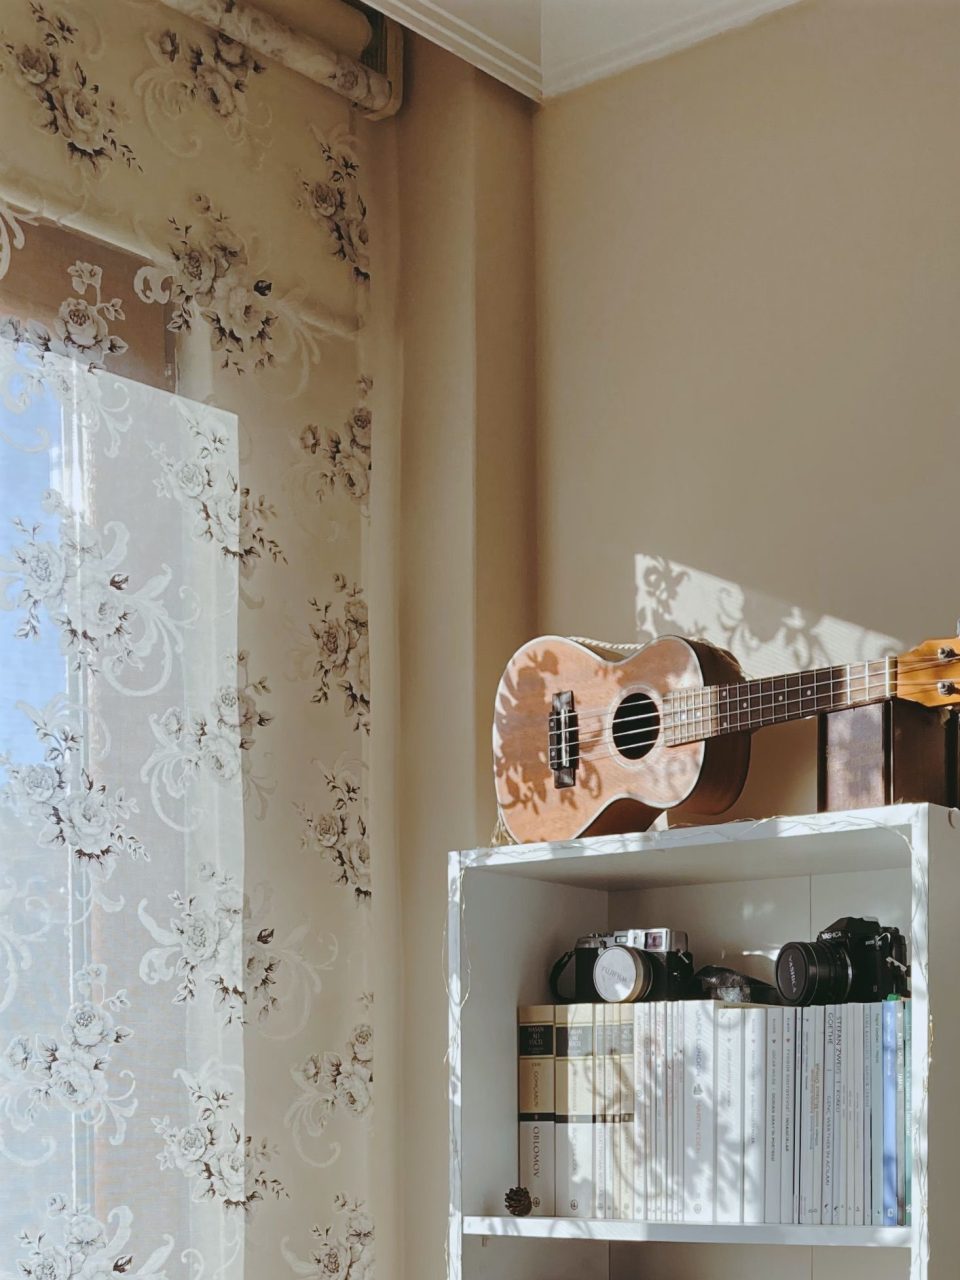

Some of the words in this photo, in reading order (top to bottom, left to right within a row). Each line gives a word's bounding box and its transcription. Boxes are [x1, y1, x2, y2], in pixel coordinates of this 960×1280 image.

[693, 1010, 703, 1037] JACK
[826, 1012, 834, 1045] GOETHE
[834, 1015, 843, 1047] STEFAN
[693, 1038, 703, 1077] LONDON
[834, 1048, 843, 1076] ZWEIG
[532, 1125, 542, 1178] OBLOMOV
